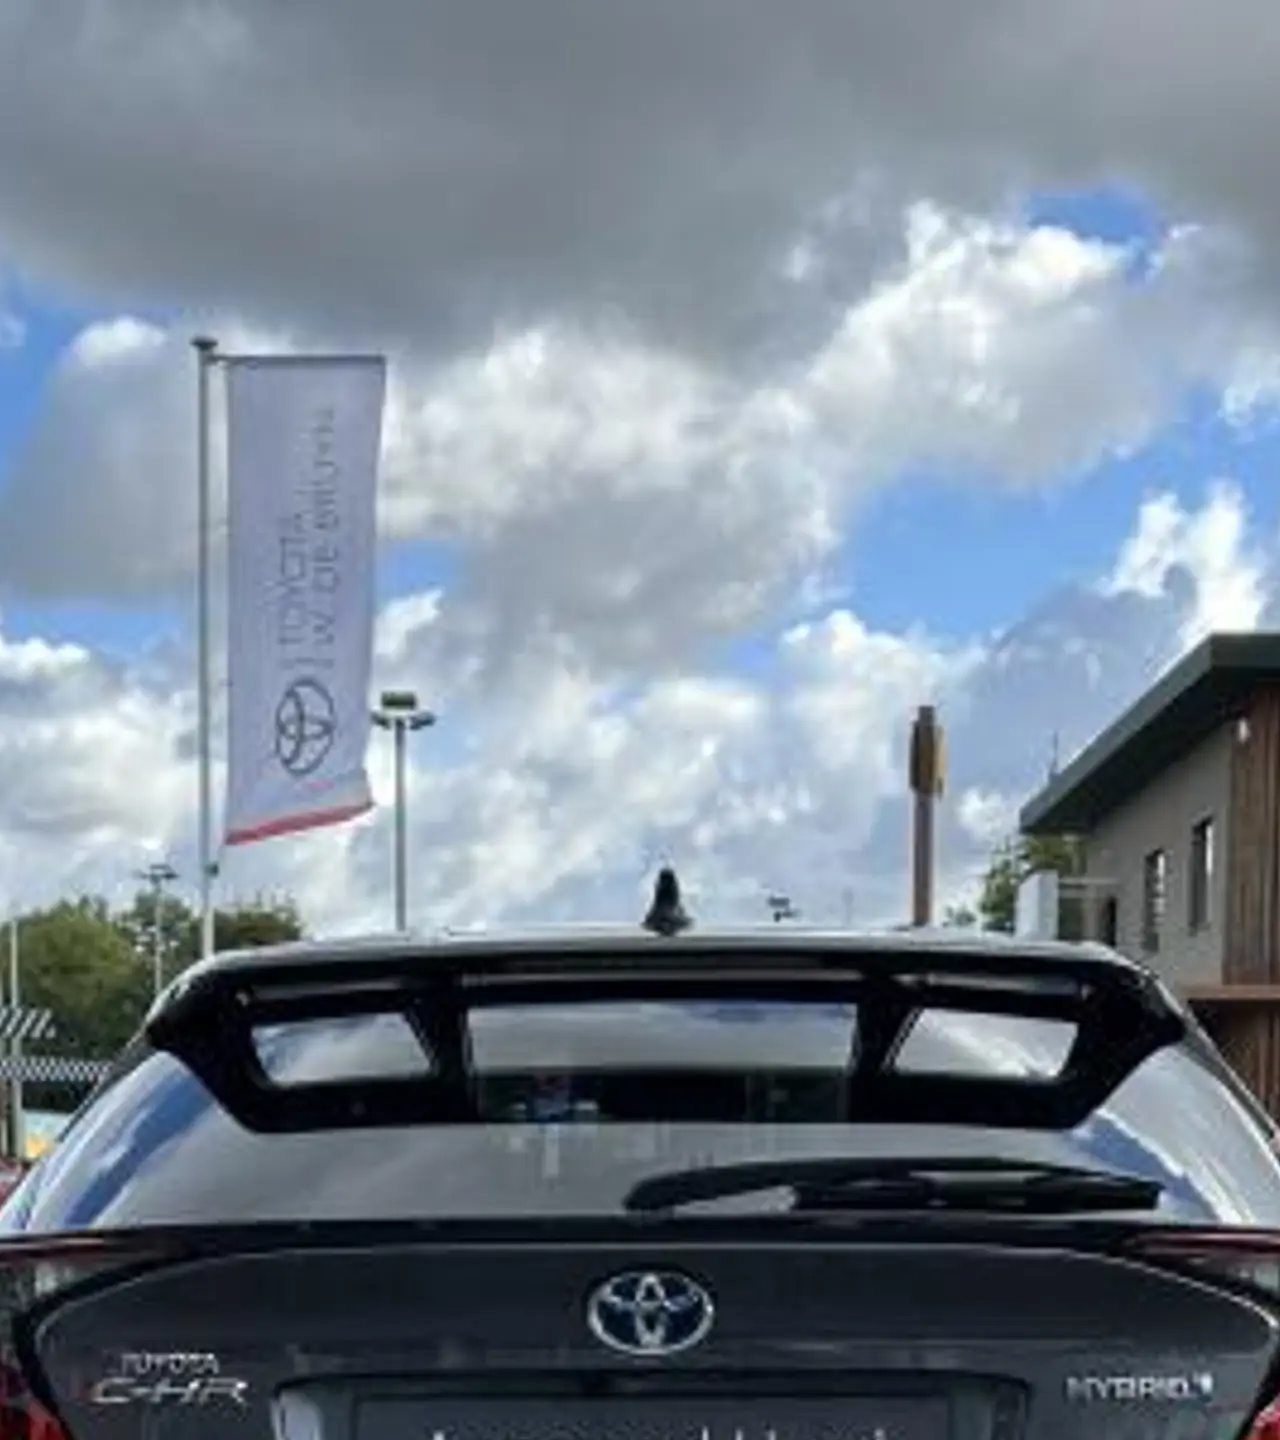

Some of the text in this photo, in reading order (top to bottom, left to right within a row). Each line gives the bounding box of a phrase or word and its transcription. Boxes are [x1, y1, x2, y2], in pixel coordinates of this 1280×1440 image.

[120, 1351, 220, 1377] TOYOTA
[90, 1376, 248, 1405] C-HR
[1065, 1376, 1188, 1400] HYBRID
